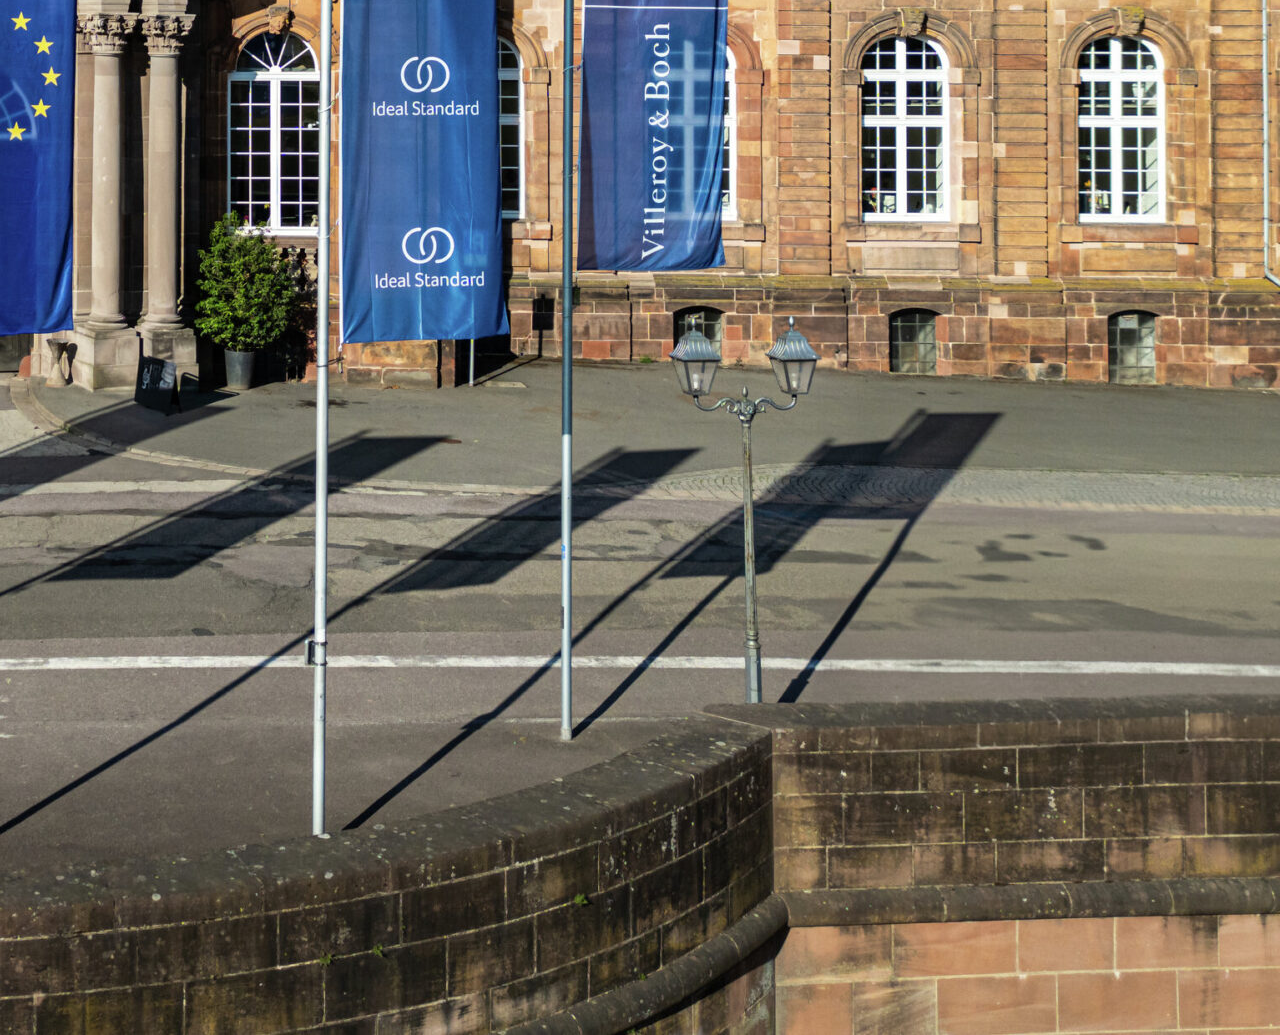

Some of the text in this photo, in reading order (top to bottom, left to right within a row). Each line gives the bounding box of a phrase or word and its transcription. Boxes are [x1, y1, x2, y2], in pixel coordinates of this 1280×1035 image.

[371, 100, 480, 117] Ideal Standard
[641, 22, 675, 260] Villeroy & Boch
[374, 271, 486, 289] Ideal Standard
